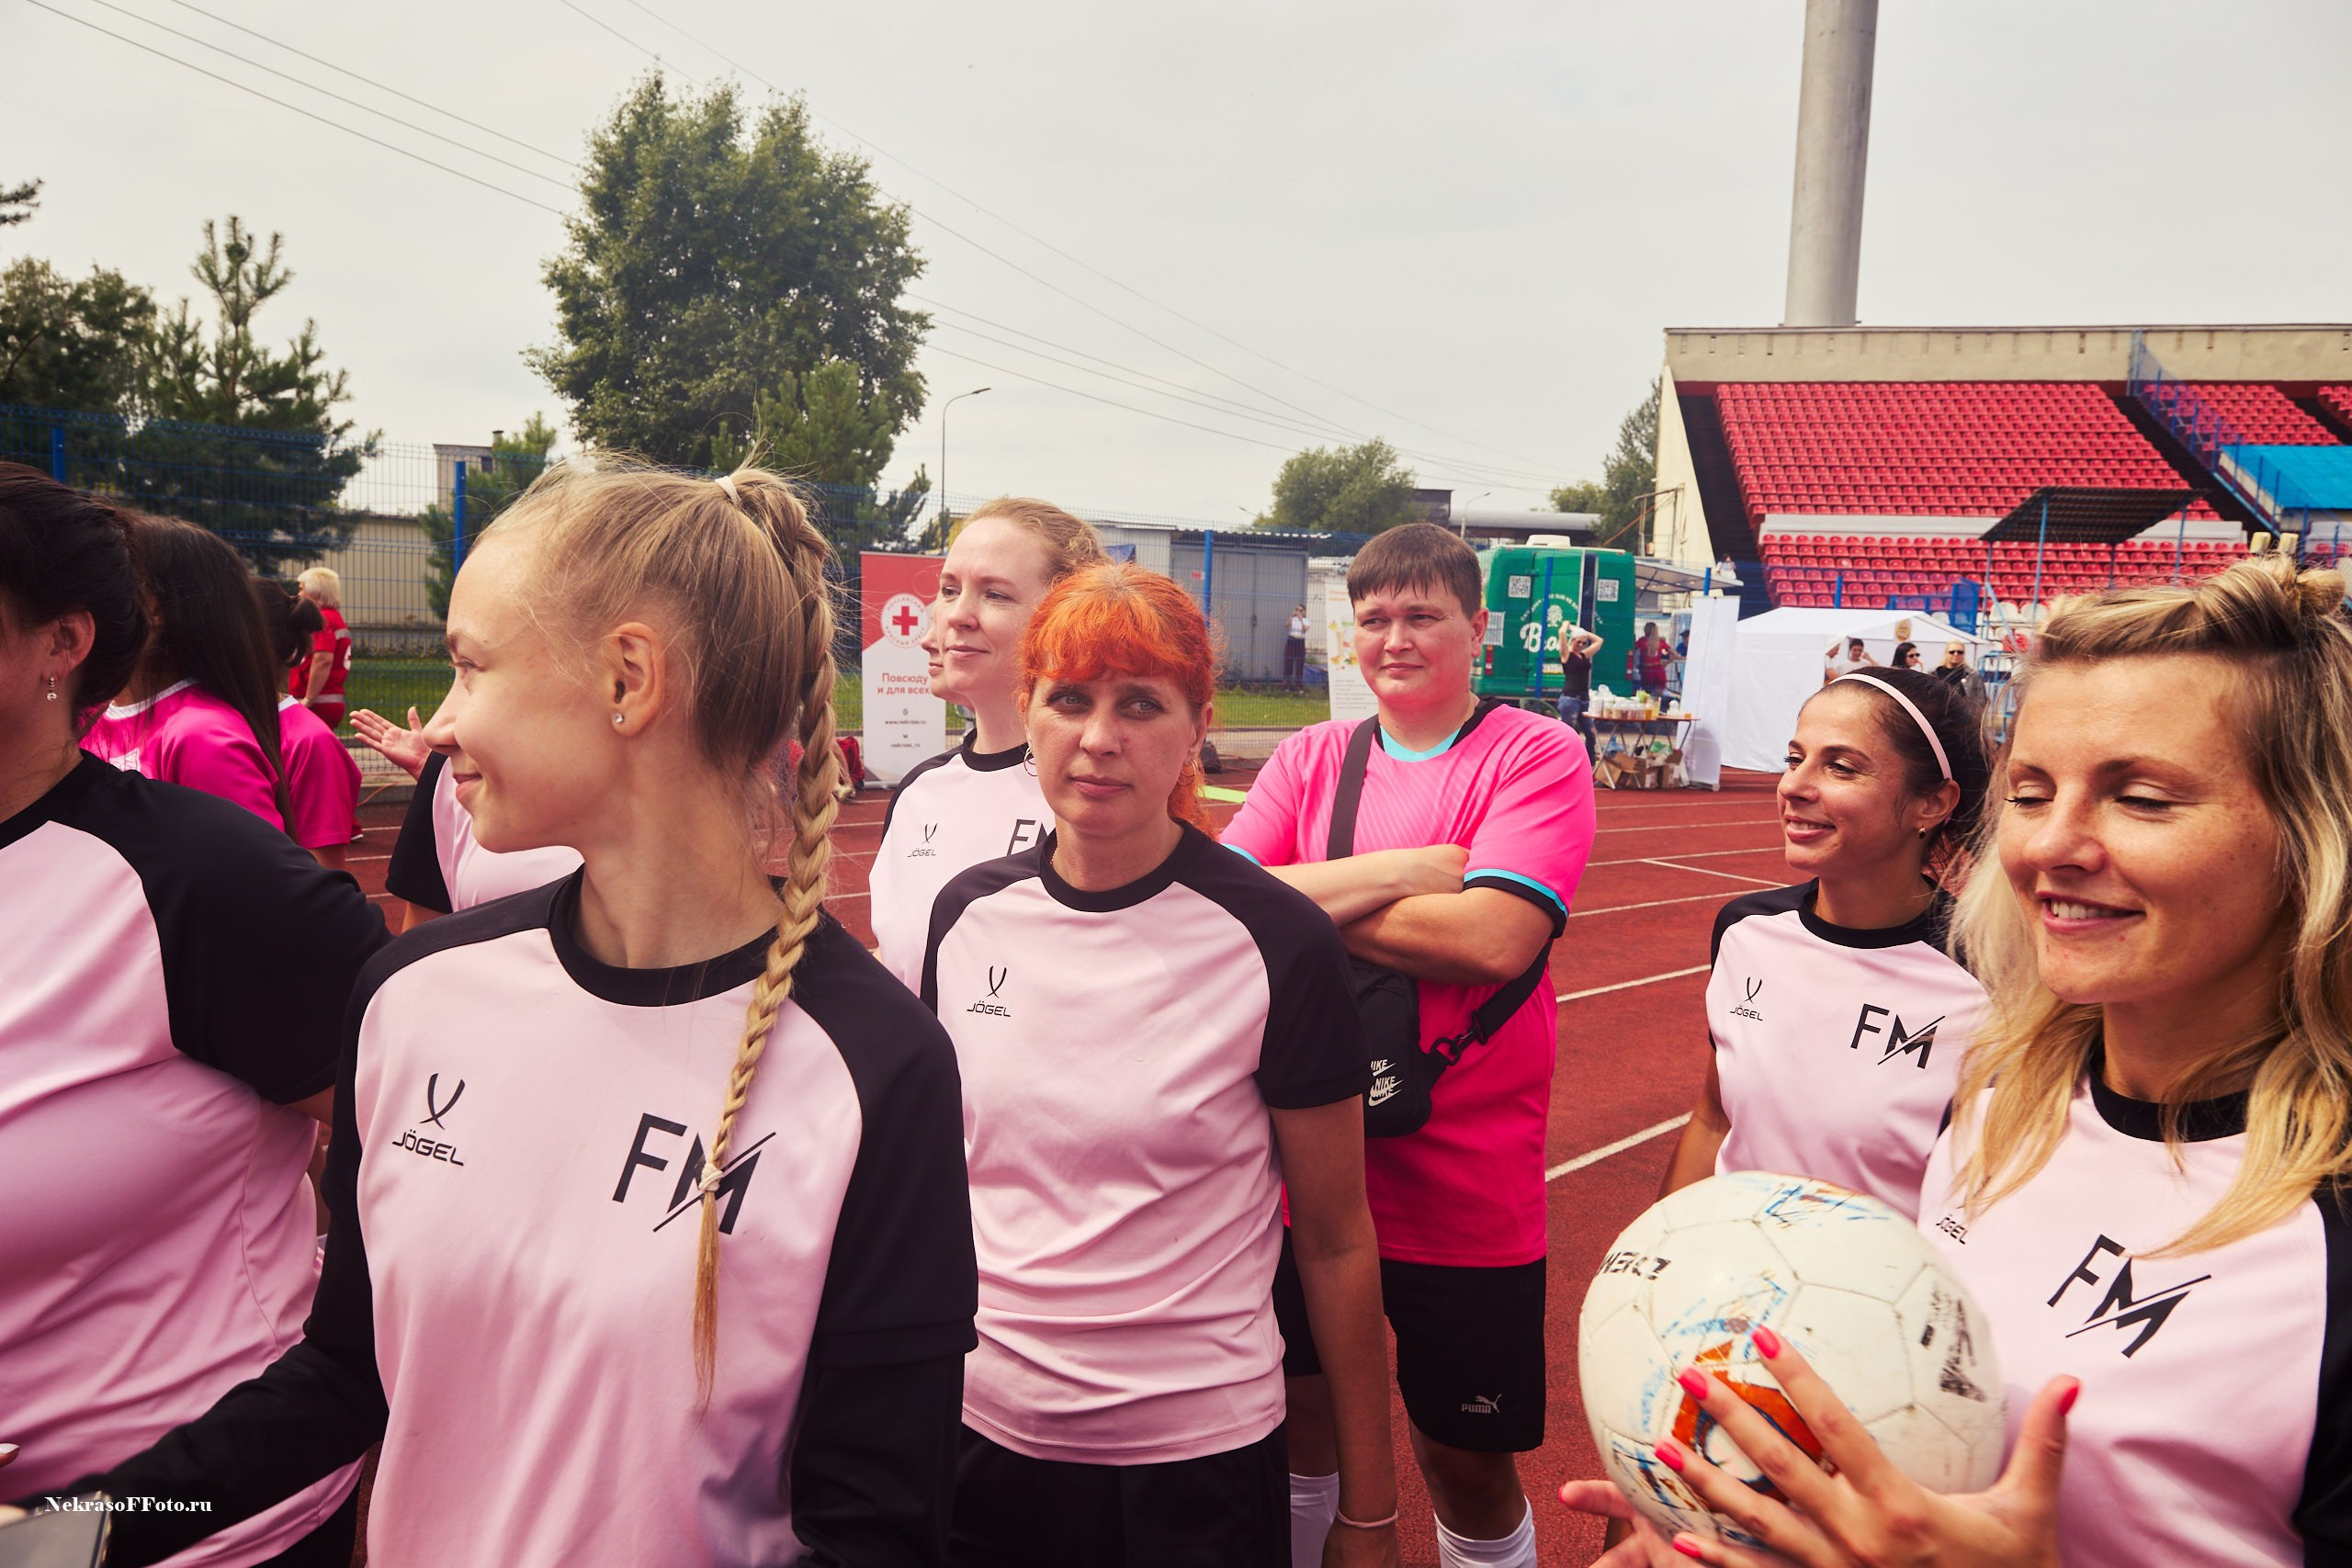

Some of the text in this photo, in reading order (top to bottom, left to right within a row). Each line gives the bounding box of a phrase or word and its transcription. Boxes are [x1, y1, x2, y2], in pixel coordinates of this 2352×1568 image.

[882, 672, 928, 685] Повсюду
[886, 687, 906, 695] для
[967, 1000, 1011, 1017] JÖGEL
[1730, 1005, 1763, 1021] JÖGEL
[1850, 1003, 1946, 1069] FM
[1374, 1076, 1396, 1091] NIKE
[391, 1129, 464, 1167] JÖGEL
[612, 1112, 776, 1235] FM
[2047, 1234, 2211, 1359] FM
[1462, 1404, 1491, 1414] PUMA
